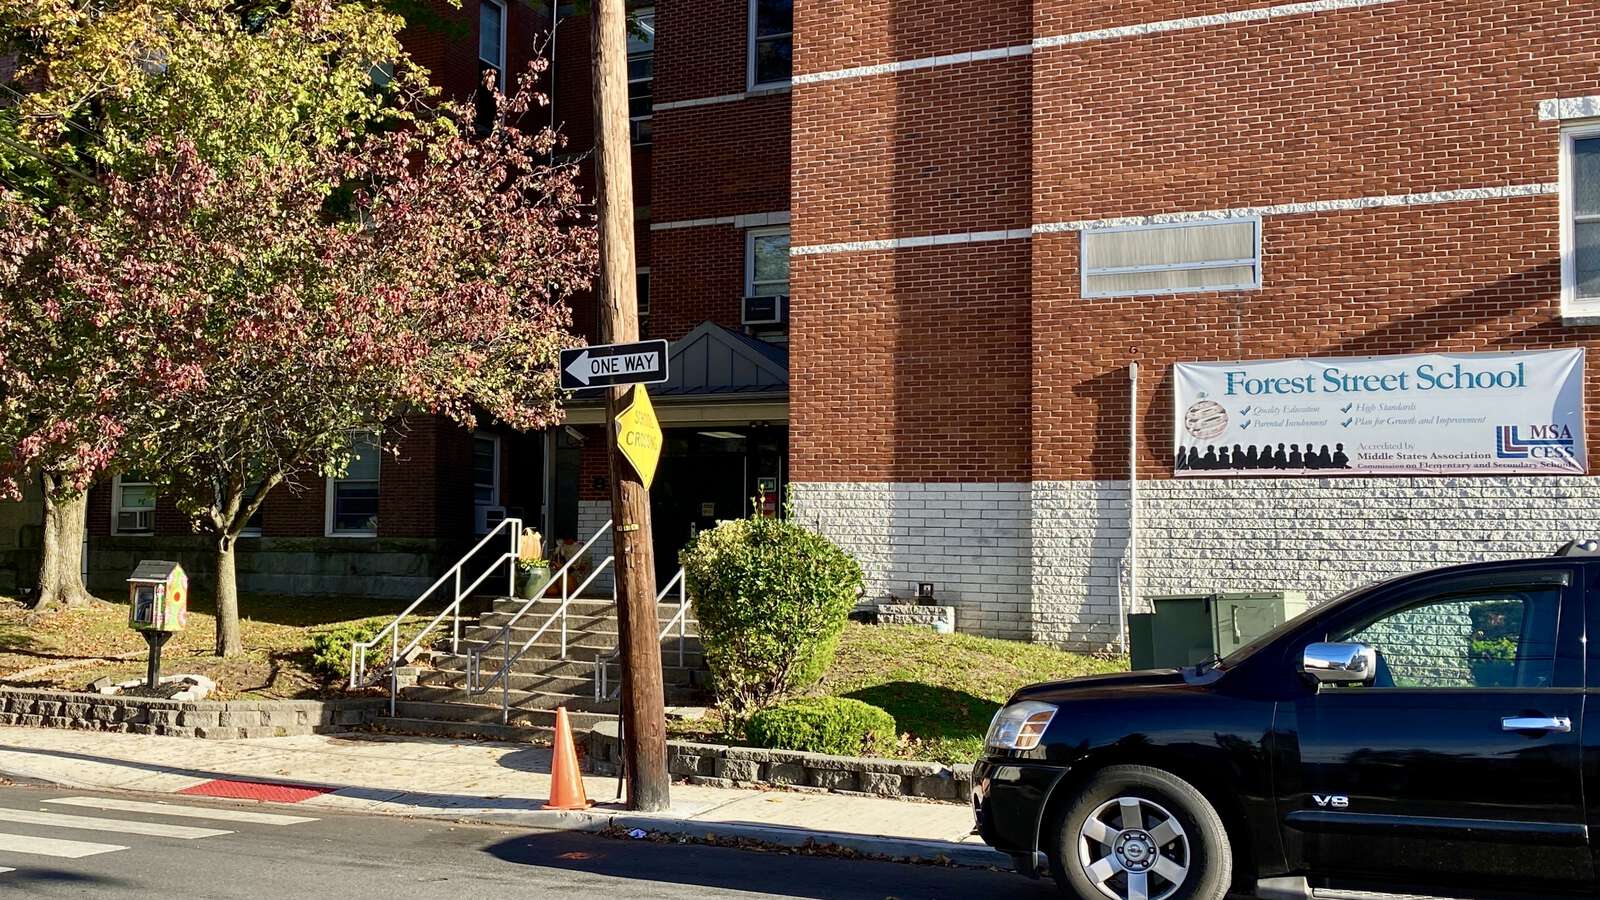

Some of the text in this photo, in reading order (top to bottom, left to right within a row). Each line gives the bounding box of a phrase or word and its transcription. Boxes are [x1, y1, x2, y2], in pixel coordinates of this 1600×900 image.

[591, 354, 655, 374] ONE WAY
[1224, 362, 1527, 396] Forest Street School
[1253, 405, 1320, 416] Quality Education
[1356, 401, 1417, 413] High Standards
[1354, 414, 1487, 427] Plan for Growth and Improvement
[1530, 424, 1573, 439] MSA
[1357, 441, 1403, 451] Accredited
[1530, 446, 1574, 459] CESS
[1357, 450, 1491, 460] Middle States Association
[1357, 462, 1405, 470] Commission
[1419, 461, 1472, 471] Elementary
[1473, 461, 1491, 469] and
[1493, 461, 1538, 470] Secondary
[1312, 794, 1349, 807] V8
